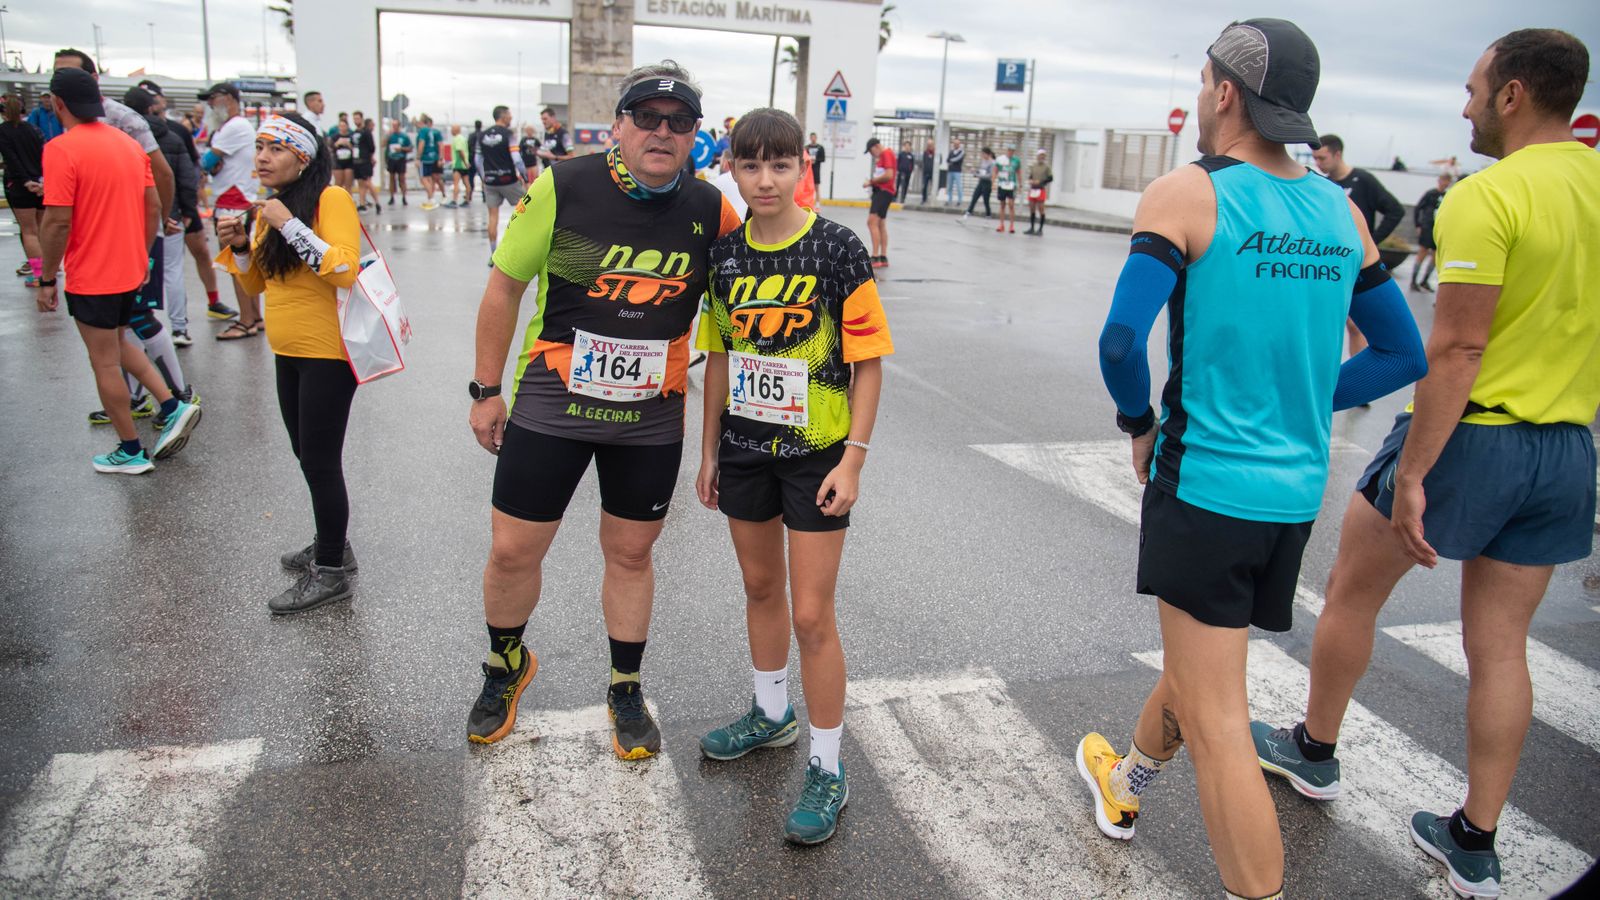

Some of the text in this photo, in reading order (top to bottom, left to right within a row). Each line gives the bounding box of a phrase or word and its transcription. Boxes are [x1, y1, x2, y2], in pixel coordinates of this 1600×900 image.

[736, 1, 813, 25] MARÍTIMA
[1006, 63, 1017, 77] P
[1236, 231, 1354, 258] Atletismo
[1255, 262, 1341, 282] FACINAS
[586, 273, 688, 306] STOP
[617, 307, 645, 319] team
[730, 306, 813, 339] STOP
[590, 339, 620, 355] XIV
[620, 343, 649, 351] CARRERA
[596, 354, 642, 381] 164
[740, 356, 762, 372] XIV
[762, 361, 788, 369] CARRERA
[775, 369, 804, 378] ESTRECHO
[747, 371, 785, 402] 165
[566, 403, 641, 422] ALGECIRAS
